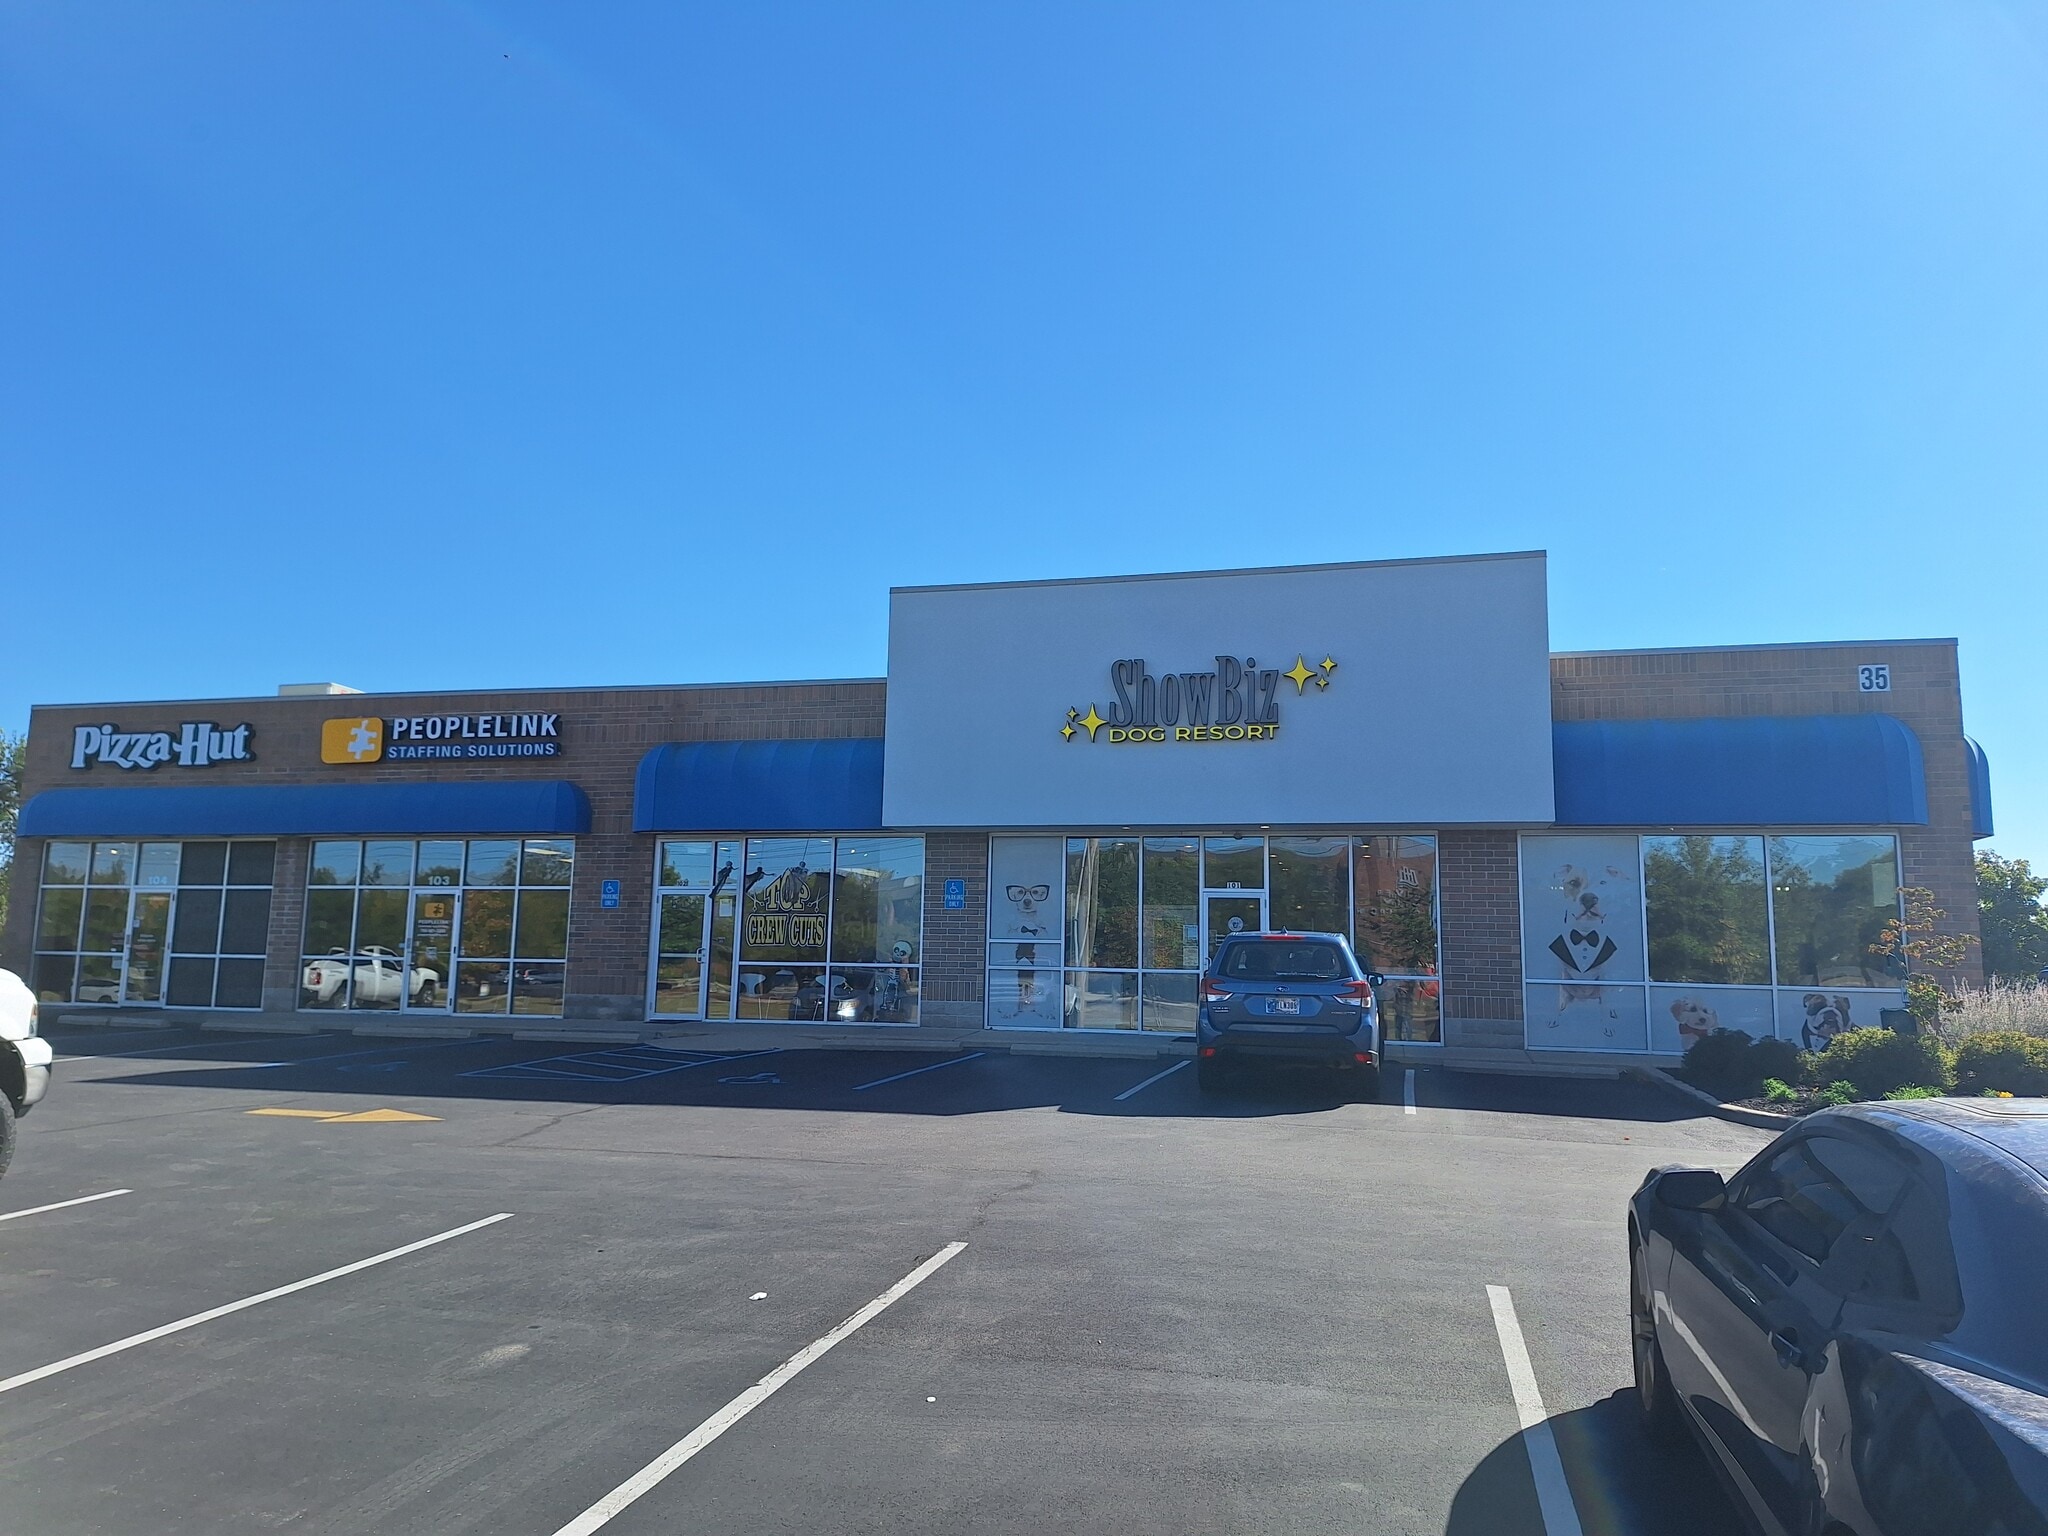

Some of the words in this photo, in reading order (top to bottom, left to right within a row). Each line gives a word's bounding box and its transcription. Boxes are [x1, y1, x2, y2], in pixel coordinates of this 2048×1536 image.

[1860, 666, 1889, 691] 35
[1109, 655, 1280, 728] ShowBiz
[392, 713, 559, 741] PEOPLELINK
[1109, 727, 1166, 743] DOG
[1174, 724, 1280, 742] RESORT
[70, 723, 172, 769] Pizza
[171, 722, 249, 766] Hut
[388, 745, 462, 759] STAFFING
[467, 743, 556, 758] SOLUTIONS
[147, 875, 169, 885] 104
[427, 875, 451, 886] 103
[1226, 881, 1241, 889] 101
[746, 914, 788, 946] CREW
[789, 914, 827, 946] CUTS
